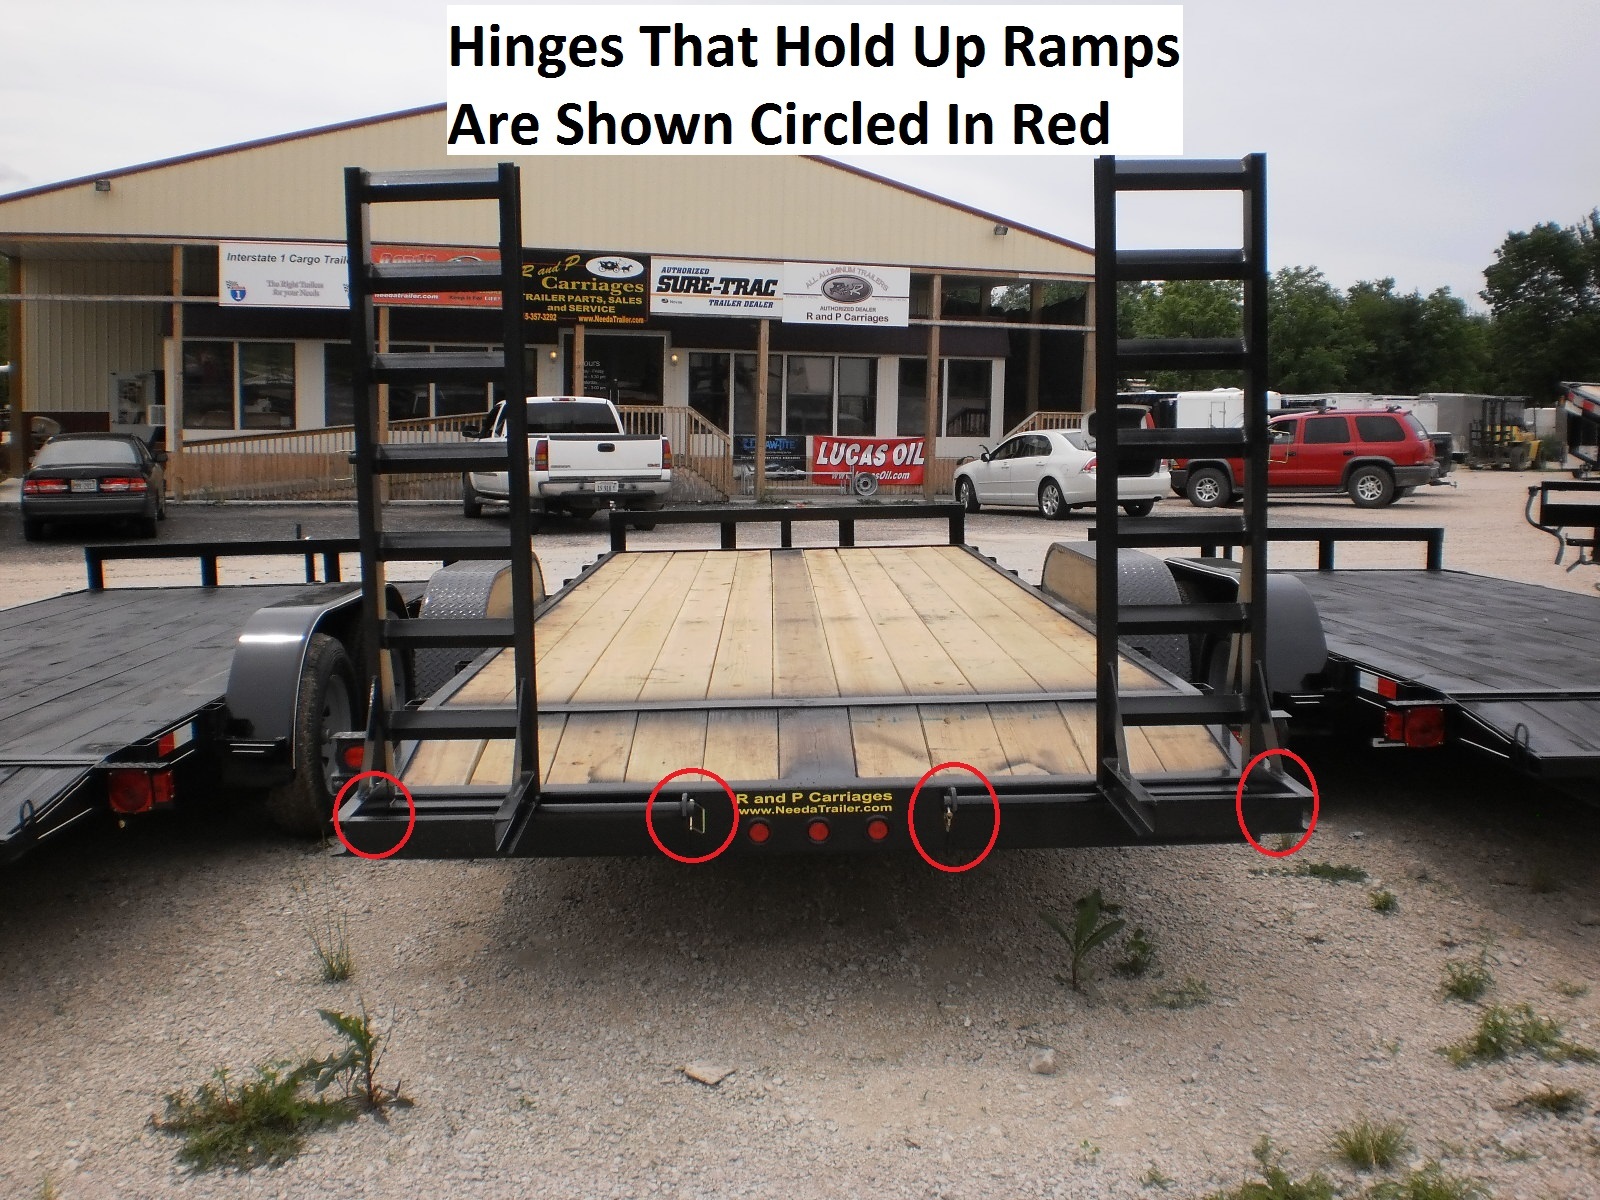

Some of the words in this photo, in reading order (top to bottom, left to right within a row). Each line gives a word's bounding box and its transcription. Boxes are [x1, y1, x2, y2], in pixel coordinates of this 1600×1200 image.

[227, 253, 277, 263] Interstate
[281, 254, 286, 262] 1
[290, 255, 321, 265] Cargo
[325, 255, 349, 265] Trail
[537, 260, 561, 276] and
[564, 254, 581, 271] P
[661, 267, 710, 275] AUTHORIZED
[805, 278, 819, 289] ALL
[819, 266, 857, 279] ALUMINUM
[857, 268, 890, 292] TRAILERS
[541, 275, 645, 296] Carriages
[656, 275, 779, 297] SURE-TRAC
[523, 293, 566, 302] RAILER
[608, 297, 643, 305] SALES
[708, 299, 742, 308] TRAILER
[743, 300, 774, 309] DEALER
[547, 304, 567, 312] and
[568, 304, 616, 314] SERVICE
[855, 305, 877, 313] DEALER
[806, 312, 814, 320] R
[816, 312, 833, 321] and
[835, 313, 842, 321] P
[844, 313, 889, 324] Carriages
[816, 441, 889, 466] LUCAS
[892, 442, 925, 465] OIL
[736, 793, 748, 804] R
[754, 793, 786, 803] and
[791, 793, 804, 803] P
[808, 791, 893, 803] Carriages
[738, 804, 893, 815] www.NeedaTrailer.com
